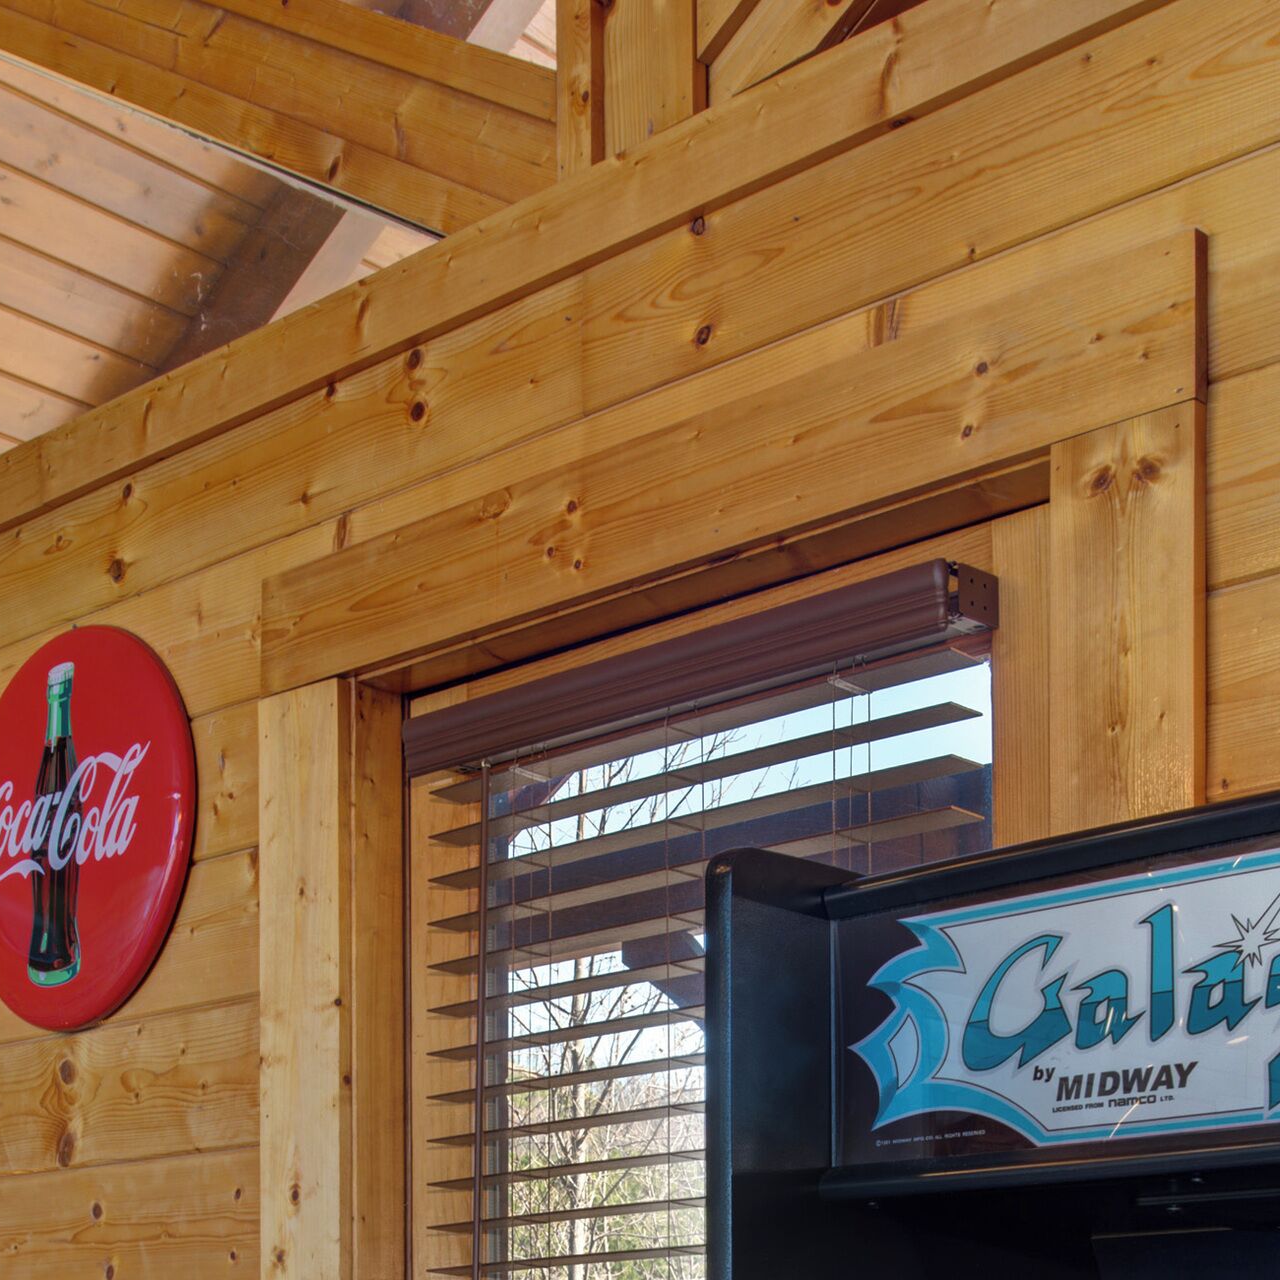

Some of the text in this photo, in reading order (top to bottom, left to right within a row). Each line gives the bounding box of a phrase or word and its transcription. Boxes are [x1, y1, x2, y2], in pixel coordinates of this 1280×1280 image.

[1032, 1065, 1056, 1083] by
[1056, 1061, 1199, 1102] MIDWAY
[1052, 1104, 1084, 1113] LICENSED
[1085, 1102, 1104, 1110] FROM
[1108, 1094, 1157, 1108] namco
